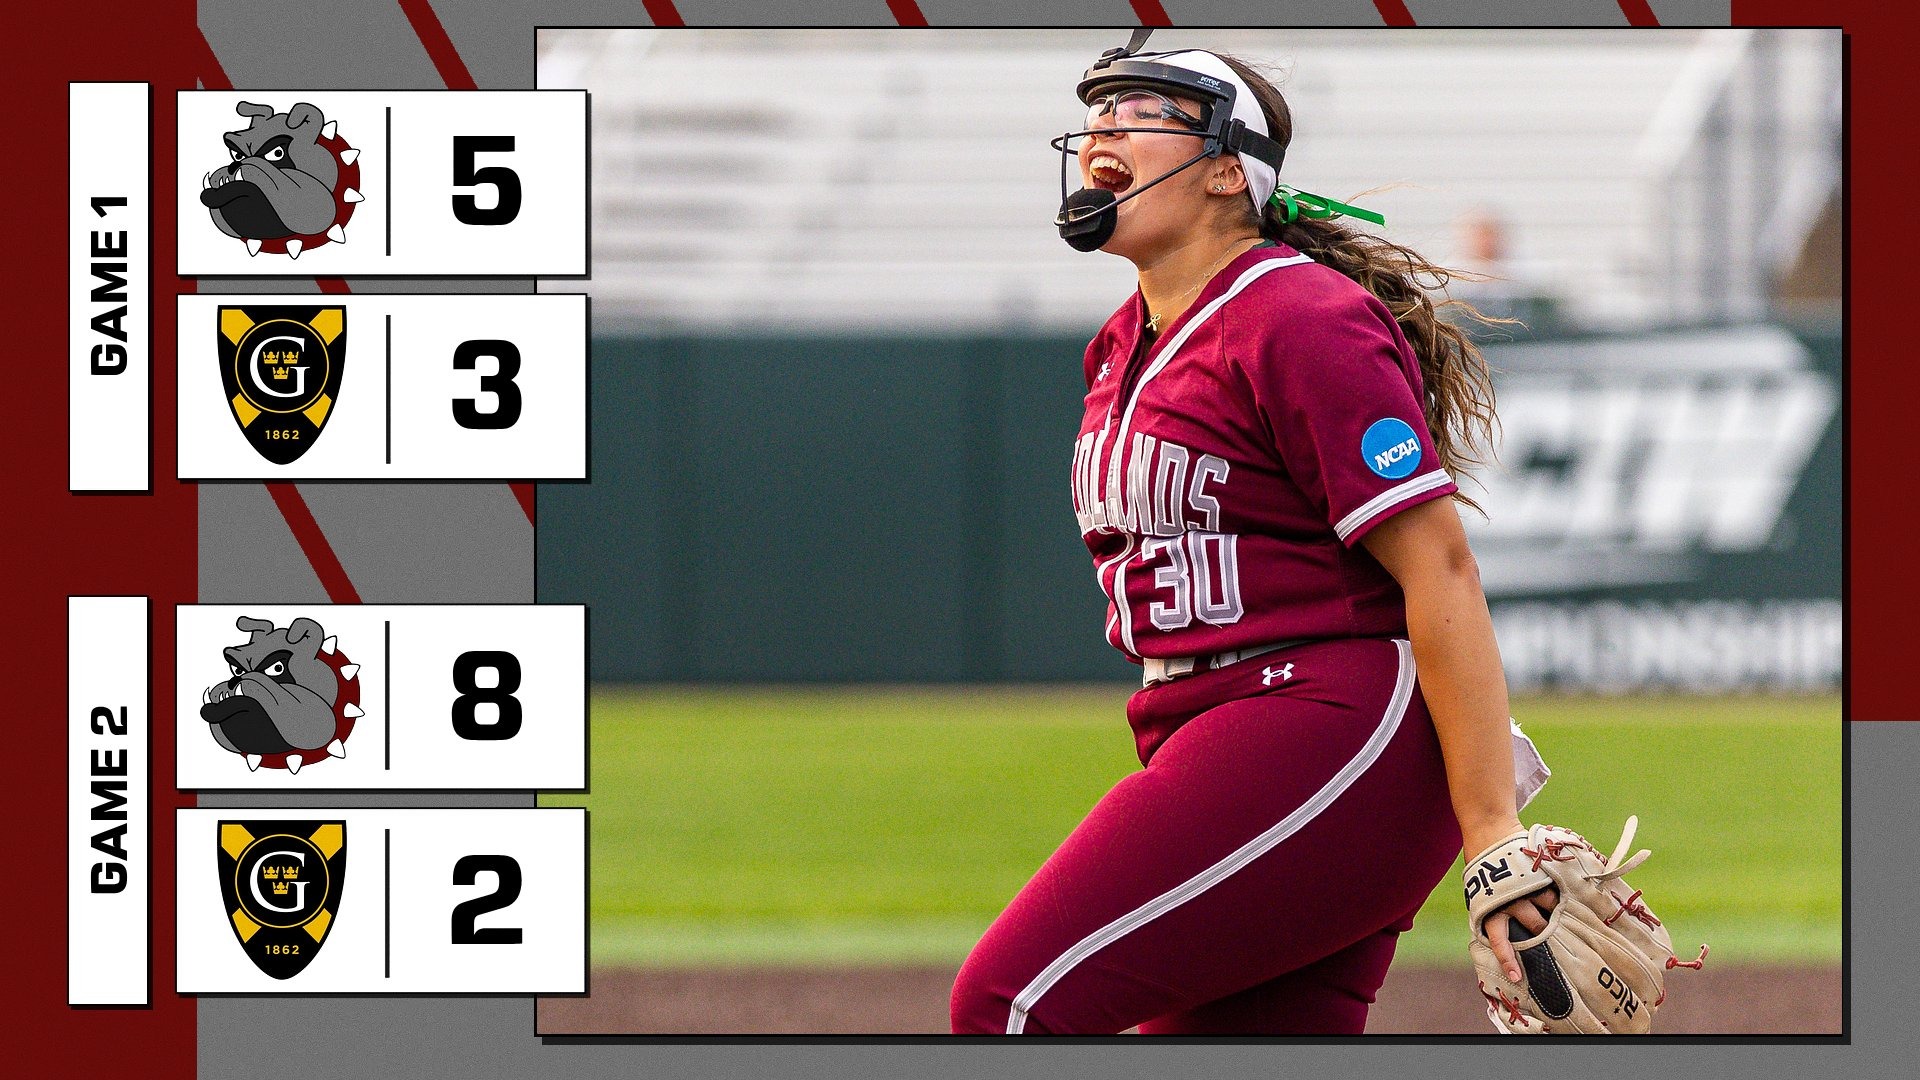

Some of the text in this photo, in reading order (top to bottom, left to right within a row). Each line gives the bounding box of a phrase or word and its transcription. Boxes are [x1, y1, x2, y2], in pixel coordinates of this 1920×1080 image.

[1071, 431, 1230, 537] DLANDS
[1374, 438, 1420, 471] NCAA
[1141, 531, 1244, 630] 30
